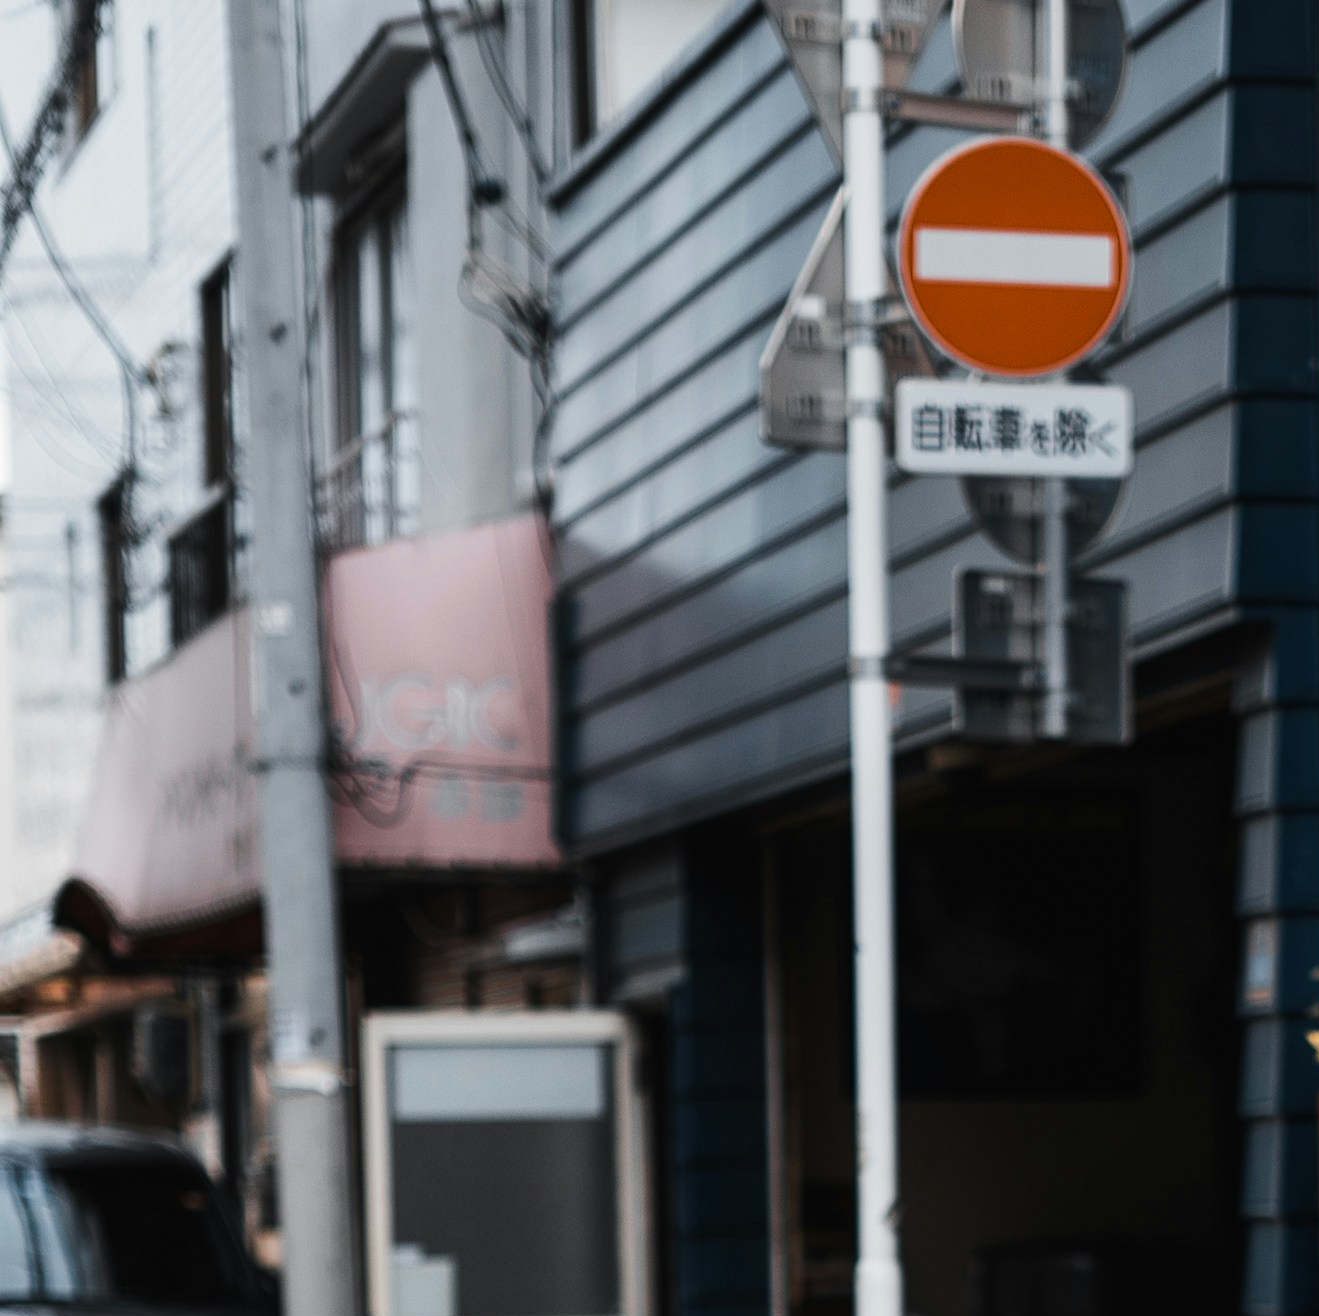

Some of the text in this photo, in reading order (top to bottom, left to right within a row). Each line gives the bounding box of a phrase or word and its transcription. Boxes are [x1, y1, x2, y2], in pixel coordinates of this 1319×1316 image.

[912, 402, 1118, 456] 自転車を除く
